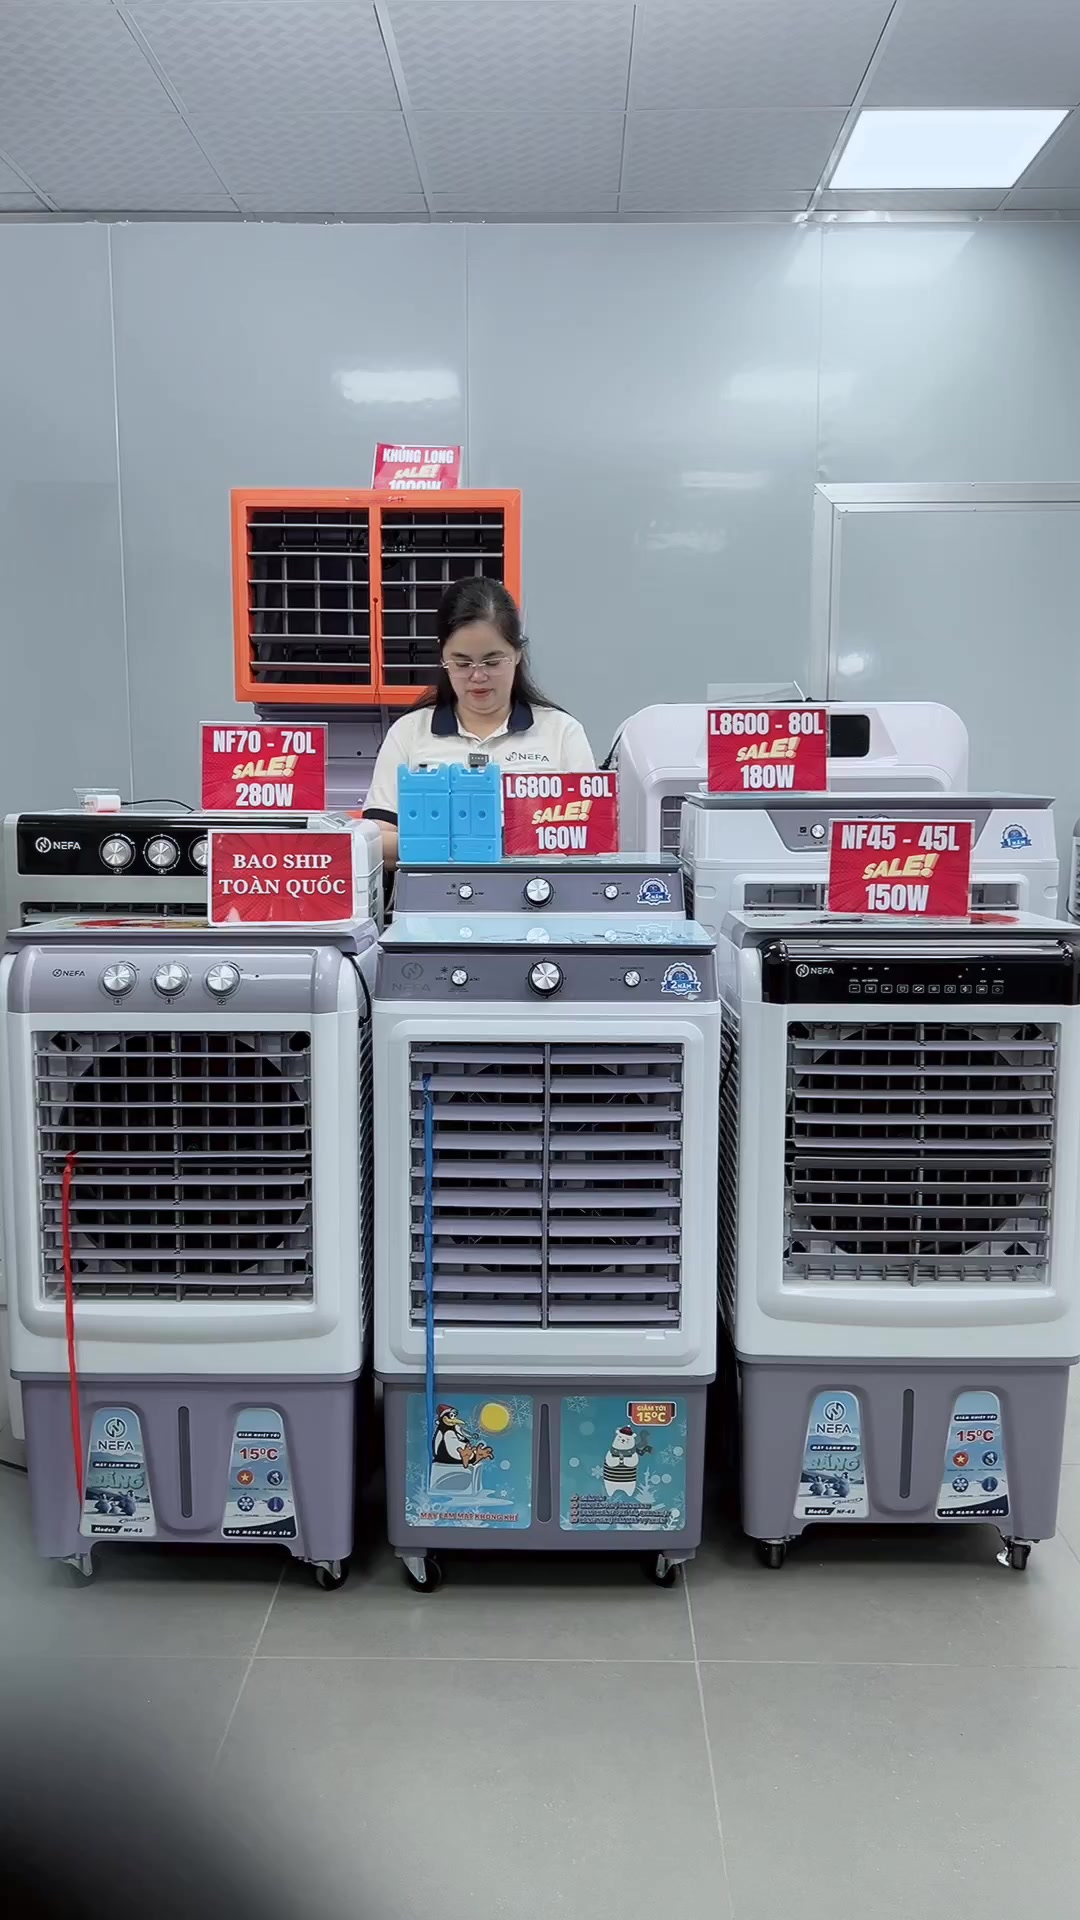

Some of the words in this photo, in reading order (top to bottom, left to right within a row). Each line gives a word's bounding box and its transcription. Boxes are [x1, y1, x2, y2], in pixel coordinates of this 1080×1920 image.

[424, 450, 454, 464] LONG
[710, 712, 769, 735] L8600
[788, 712, 824, 735] 80L
[213, 730, 261, 753] NF70
[281, 731, 316, 754] 70L
[736, 736, 801, 762] SALE!
[231, 755, 299, 780] SALE!
[518, 752, 550, 762] NEFA
[505, 776, 562, 798] L6800
[579, 776, 613, 798] 60L
[740, 764, 795, 788] 180W
[235, 783, 294, 807] 280W
[531, 799, 593, 825] SALE!
[53, 841, 81, 850] NEFA
[535, 826, 588, 850] 160W
[841, 825, 896, 850] NF45
[918, 825, 960, 851] 45L
[232, 854, 278, 869] BAO
[283, 854, 332, 869] SHIP
[861, 853, 940, 880] SALE!
[219, 875, 280, 894] TOÀN
[286, 875, 346, 898] QUỐC
[865, 883, 929, 911] 150W
[62, 969, 86, 977] NEFA
[810, 967, 834, 975] NEFA
[392, 983, 431, 992] NEFA
[671, 980, 677, 989] 2
[816, 1423, 852, 1434] NEFA
[98, 1440, 134, 1451] NEFA
